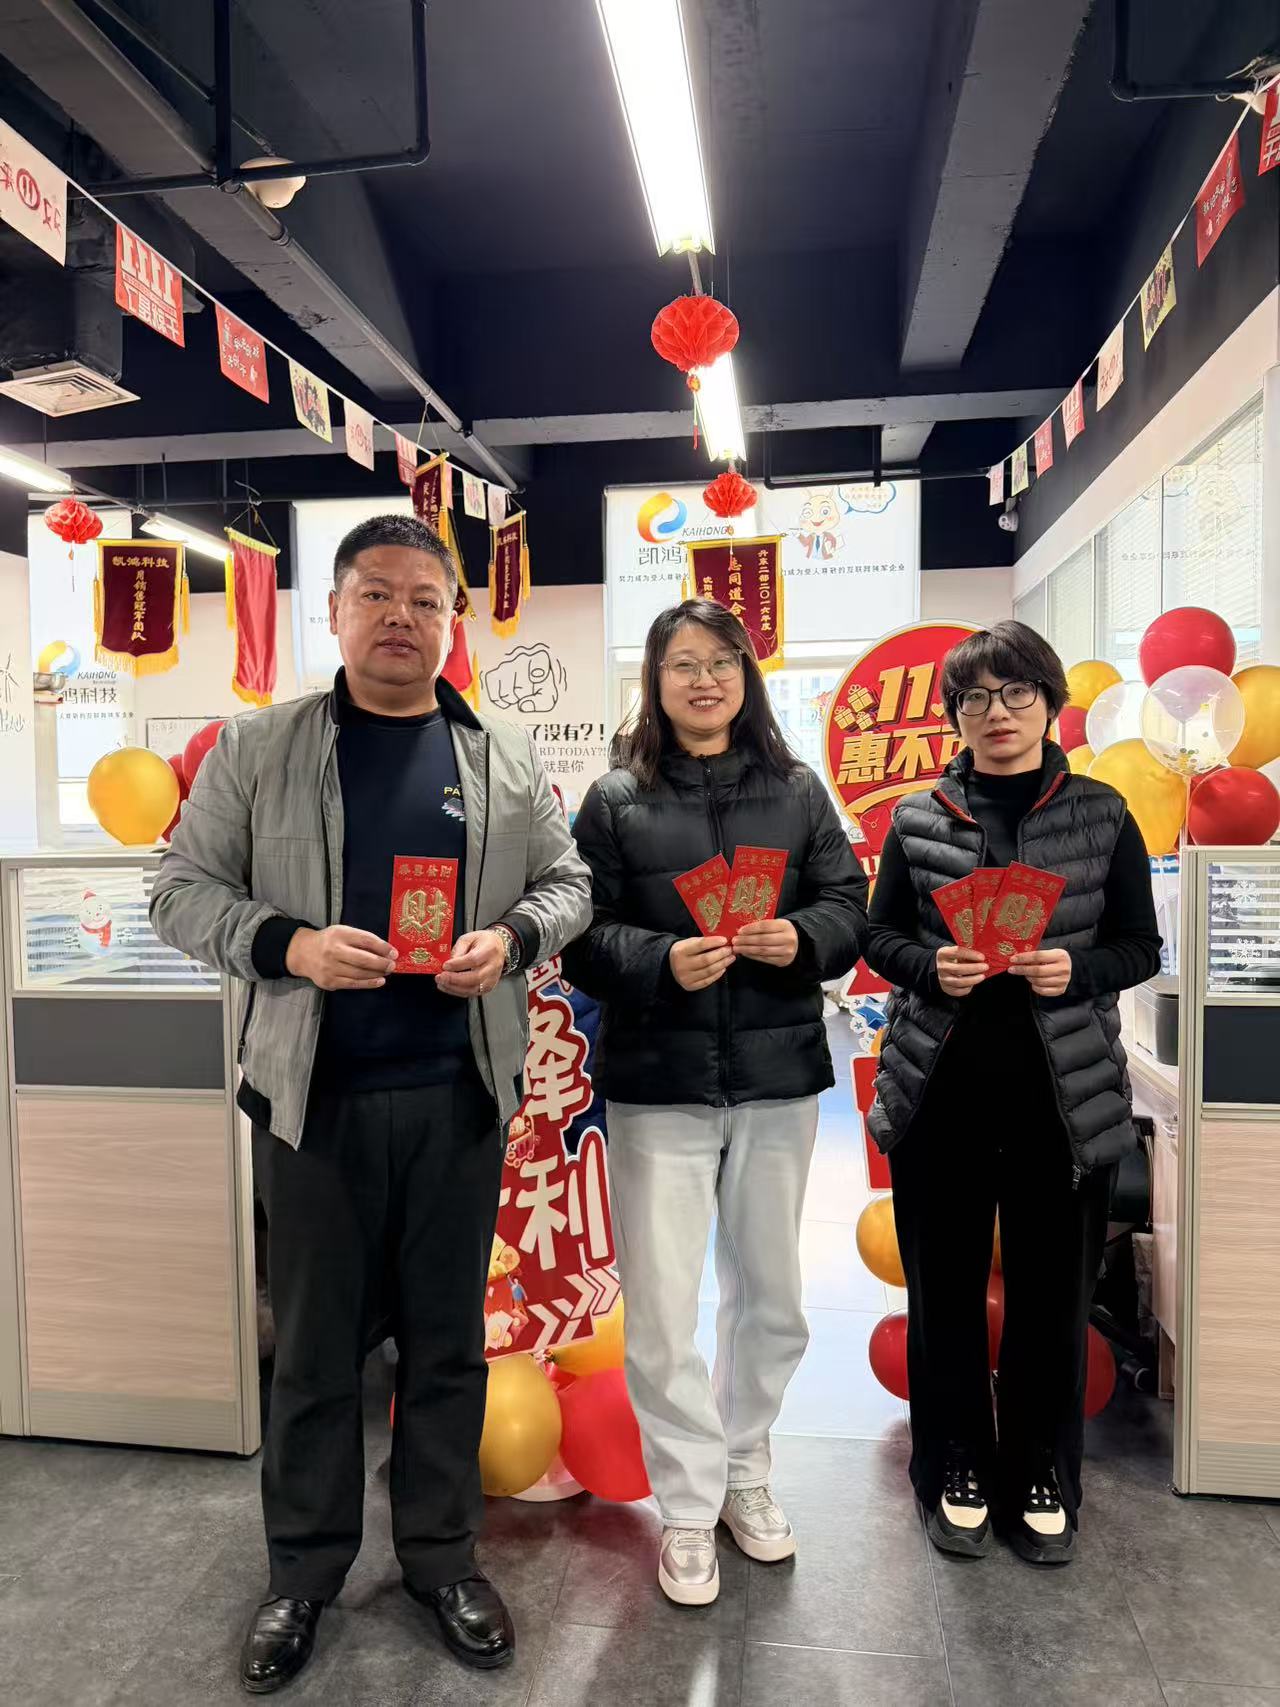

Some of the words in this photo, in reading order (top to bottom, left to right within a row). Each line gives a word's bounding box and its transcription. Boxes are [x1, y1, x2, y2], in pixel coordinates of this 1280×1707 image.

[638, 546, 688, 566] 凯鸿
[543, 760, 585, 774] 就是你
[500, 1138, 609, 1271] 利
